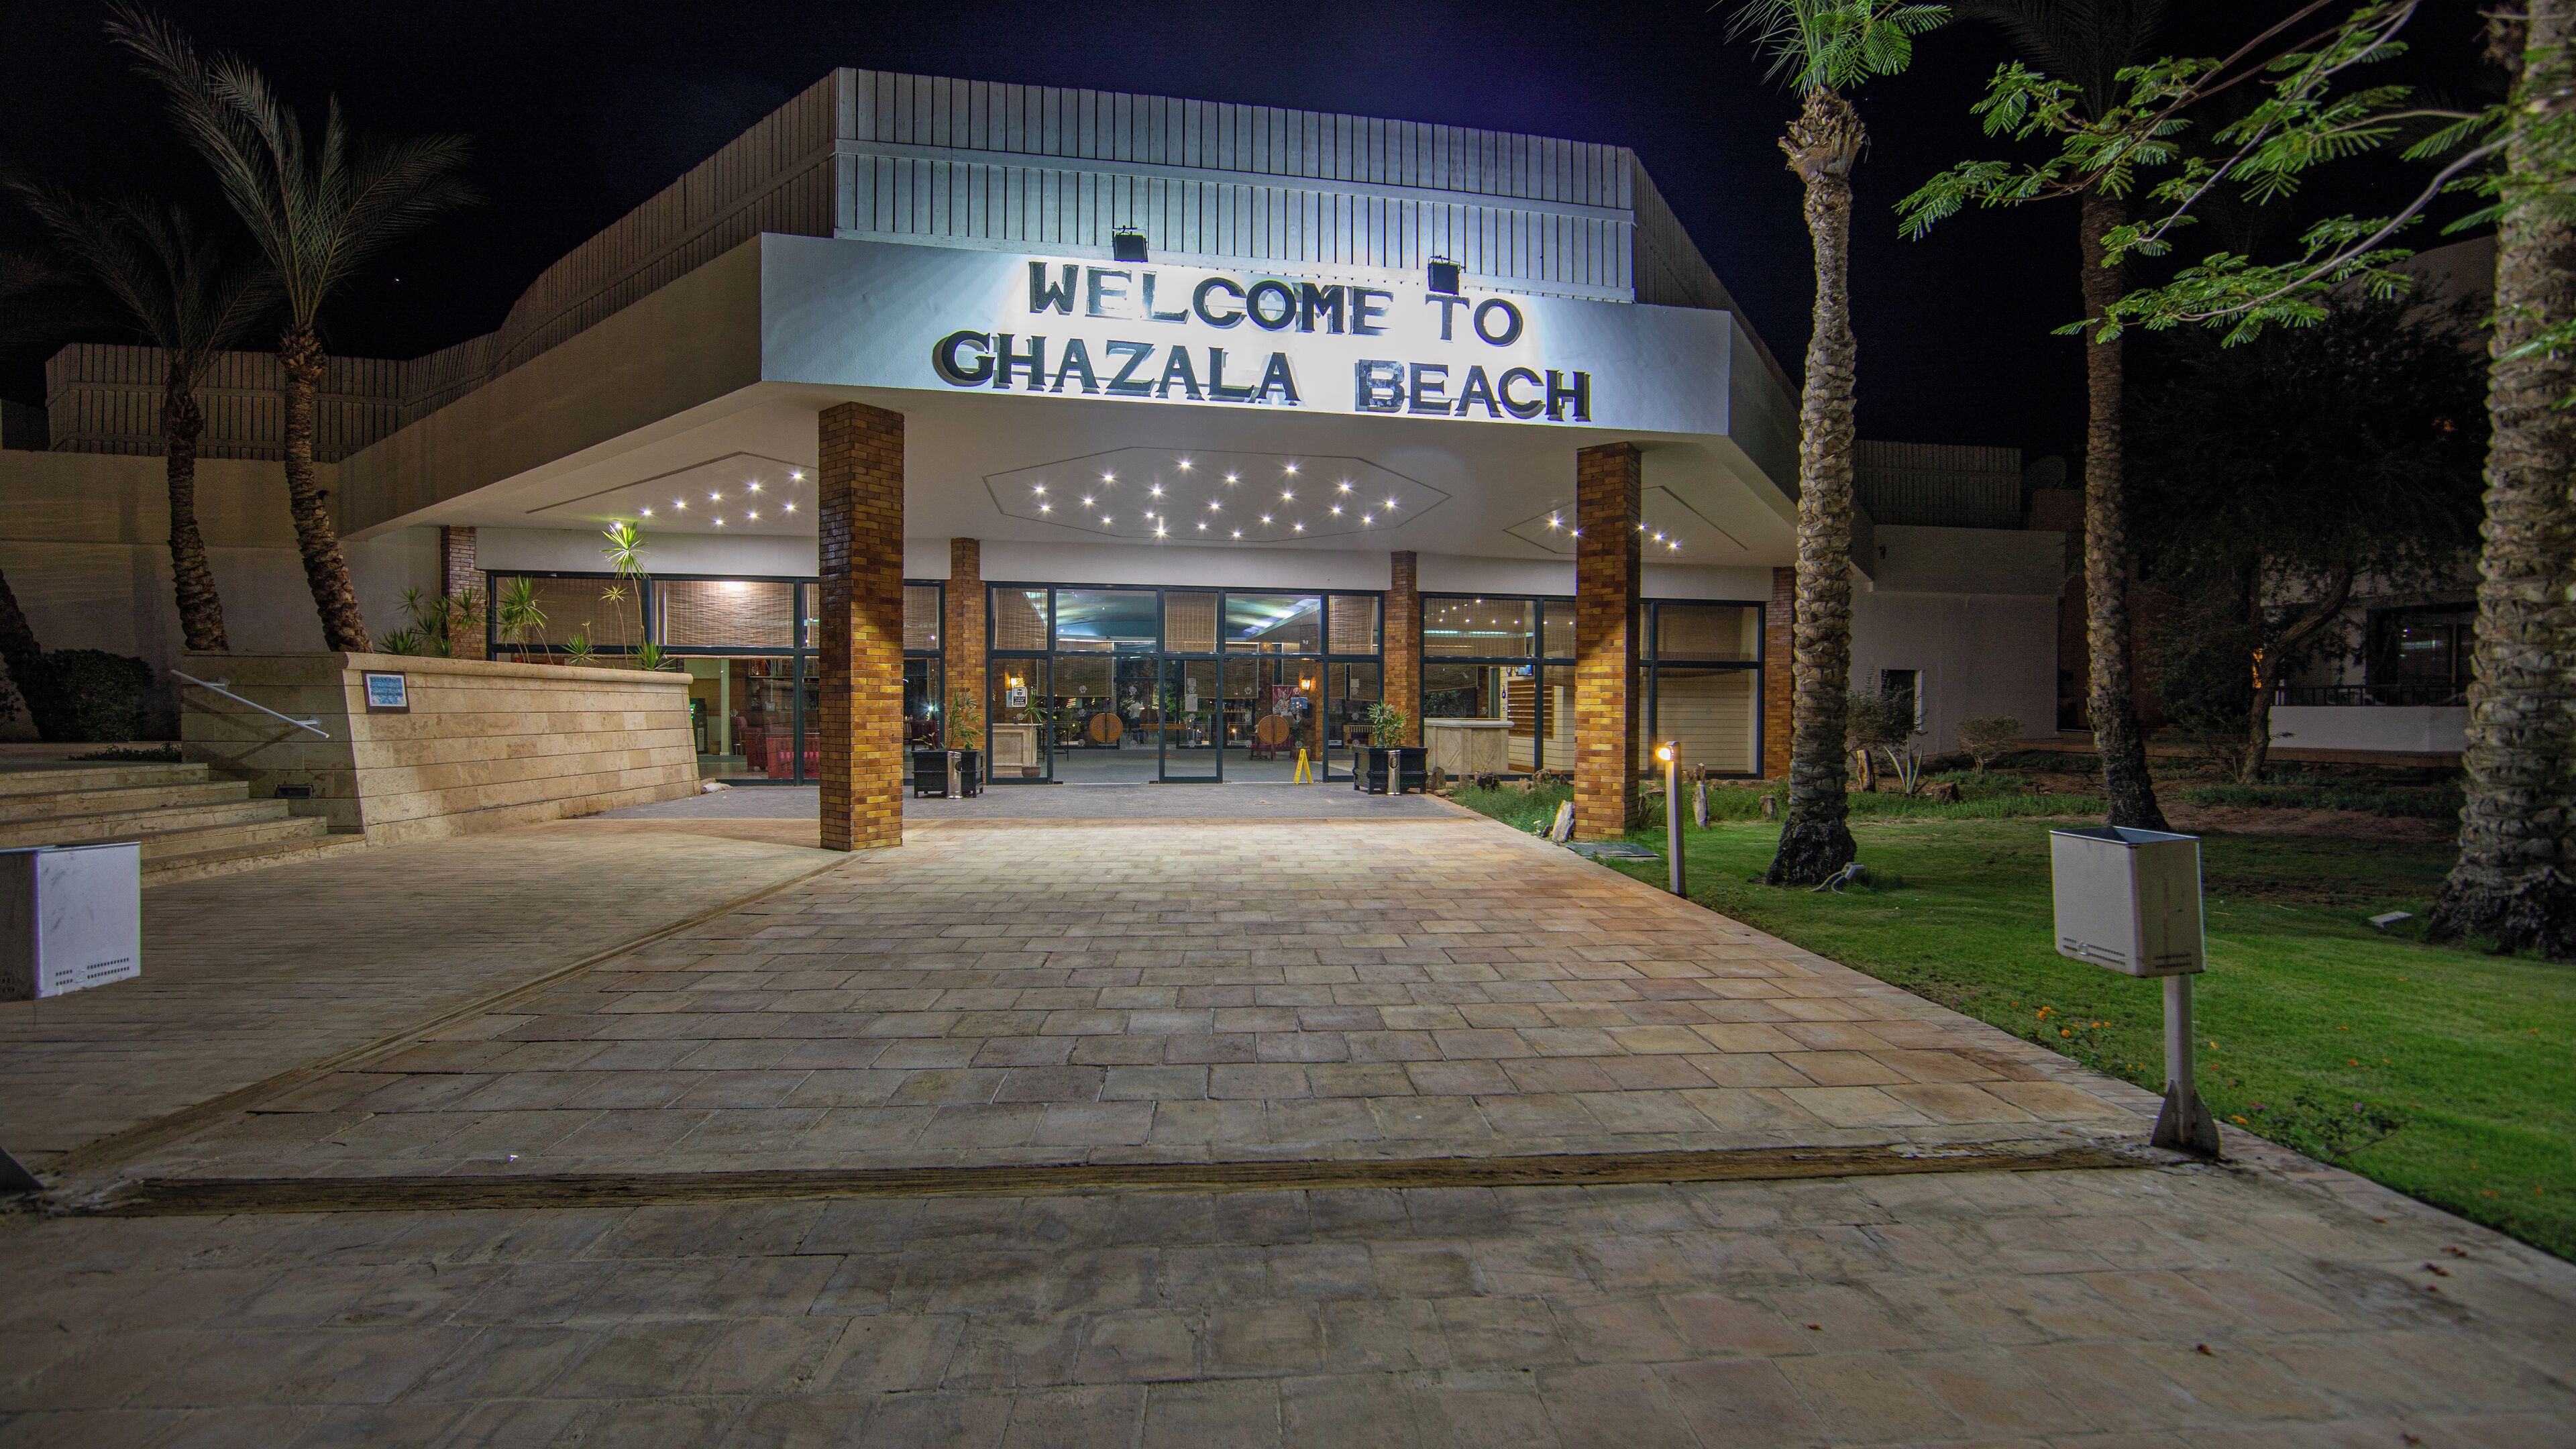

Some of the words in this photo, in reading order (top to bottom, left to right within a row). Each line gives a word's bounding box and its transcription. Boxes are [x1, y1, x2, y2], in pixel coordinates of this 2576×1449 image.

[1029, 261, 1394, 335] WELCOME
[1425, 294, 1523, 347] TO
[934, 330, 1298, 405] GHAZALA
[1356, 360, 1591, 422] BEACH
